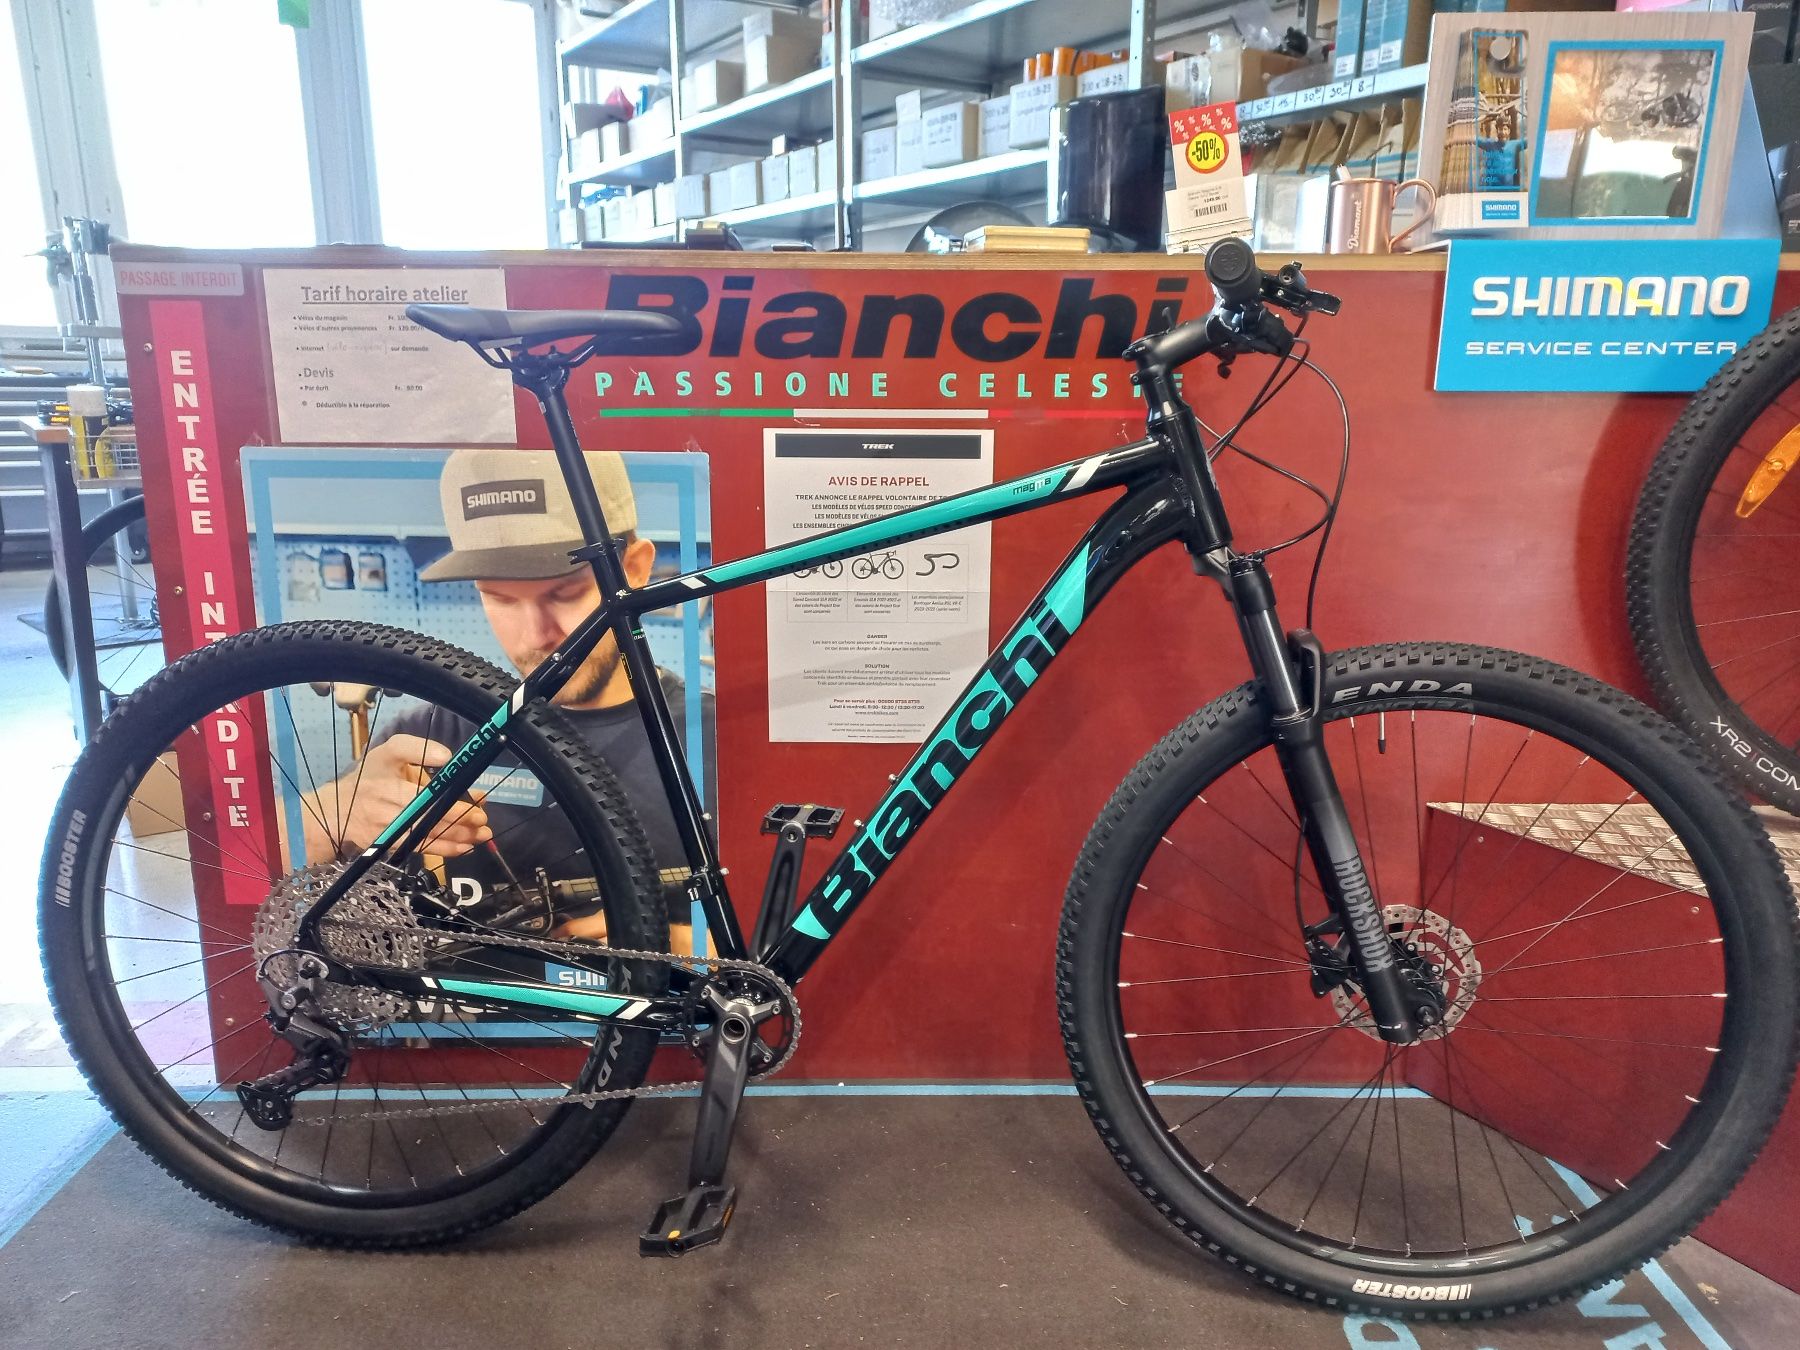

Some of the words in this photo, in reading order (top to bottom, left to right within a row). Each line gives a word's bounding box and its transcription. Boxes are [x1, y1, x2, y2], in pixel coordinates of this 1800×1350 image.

[1192, 138, 1220, 162] -50%
[1347, 200, 1362, 249] Diamant
[120, 271, 177, 287] PASSAGE
[181, 272, 238, 287] INTERDIT
[301, 286, 341, 302] Tarif
[346, 286, 408, 302] horaire
[413, 286, 468, 302] atelier
[1471, 276, 1750, 317] SHIMANO
[597, 275, 1189, 362] Bianchi
[1465, 342, 1592, 355] SERVICE
[1601, 342, 1737, 355] CENTER
[304, 367, 334, 378] Devis
[595, 371, 888, 399] PASSIONE
[828, 476, 858, 486] AVIS
[861, 476, 877, 486] DE
[881, 476, 930, 487] RAPPEL
[1013, 478, 1052, 495] magma
[467, 489, 537, 509] SHIMANO
[170, 350, 213, 535] ENTRÉE
[204, 572, 249, 828] INDITE
[1332, 680, 1473, 703] ENDA
[1709, 715, 1752, 758] XR2
[430, 720, 502, 793] Bianchi
[808, 599, 1072, 939] Bianchi
[1334, 856, 1394, 973] ROCKSHOX
